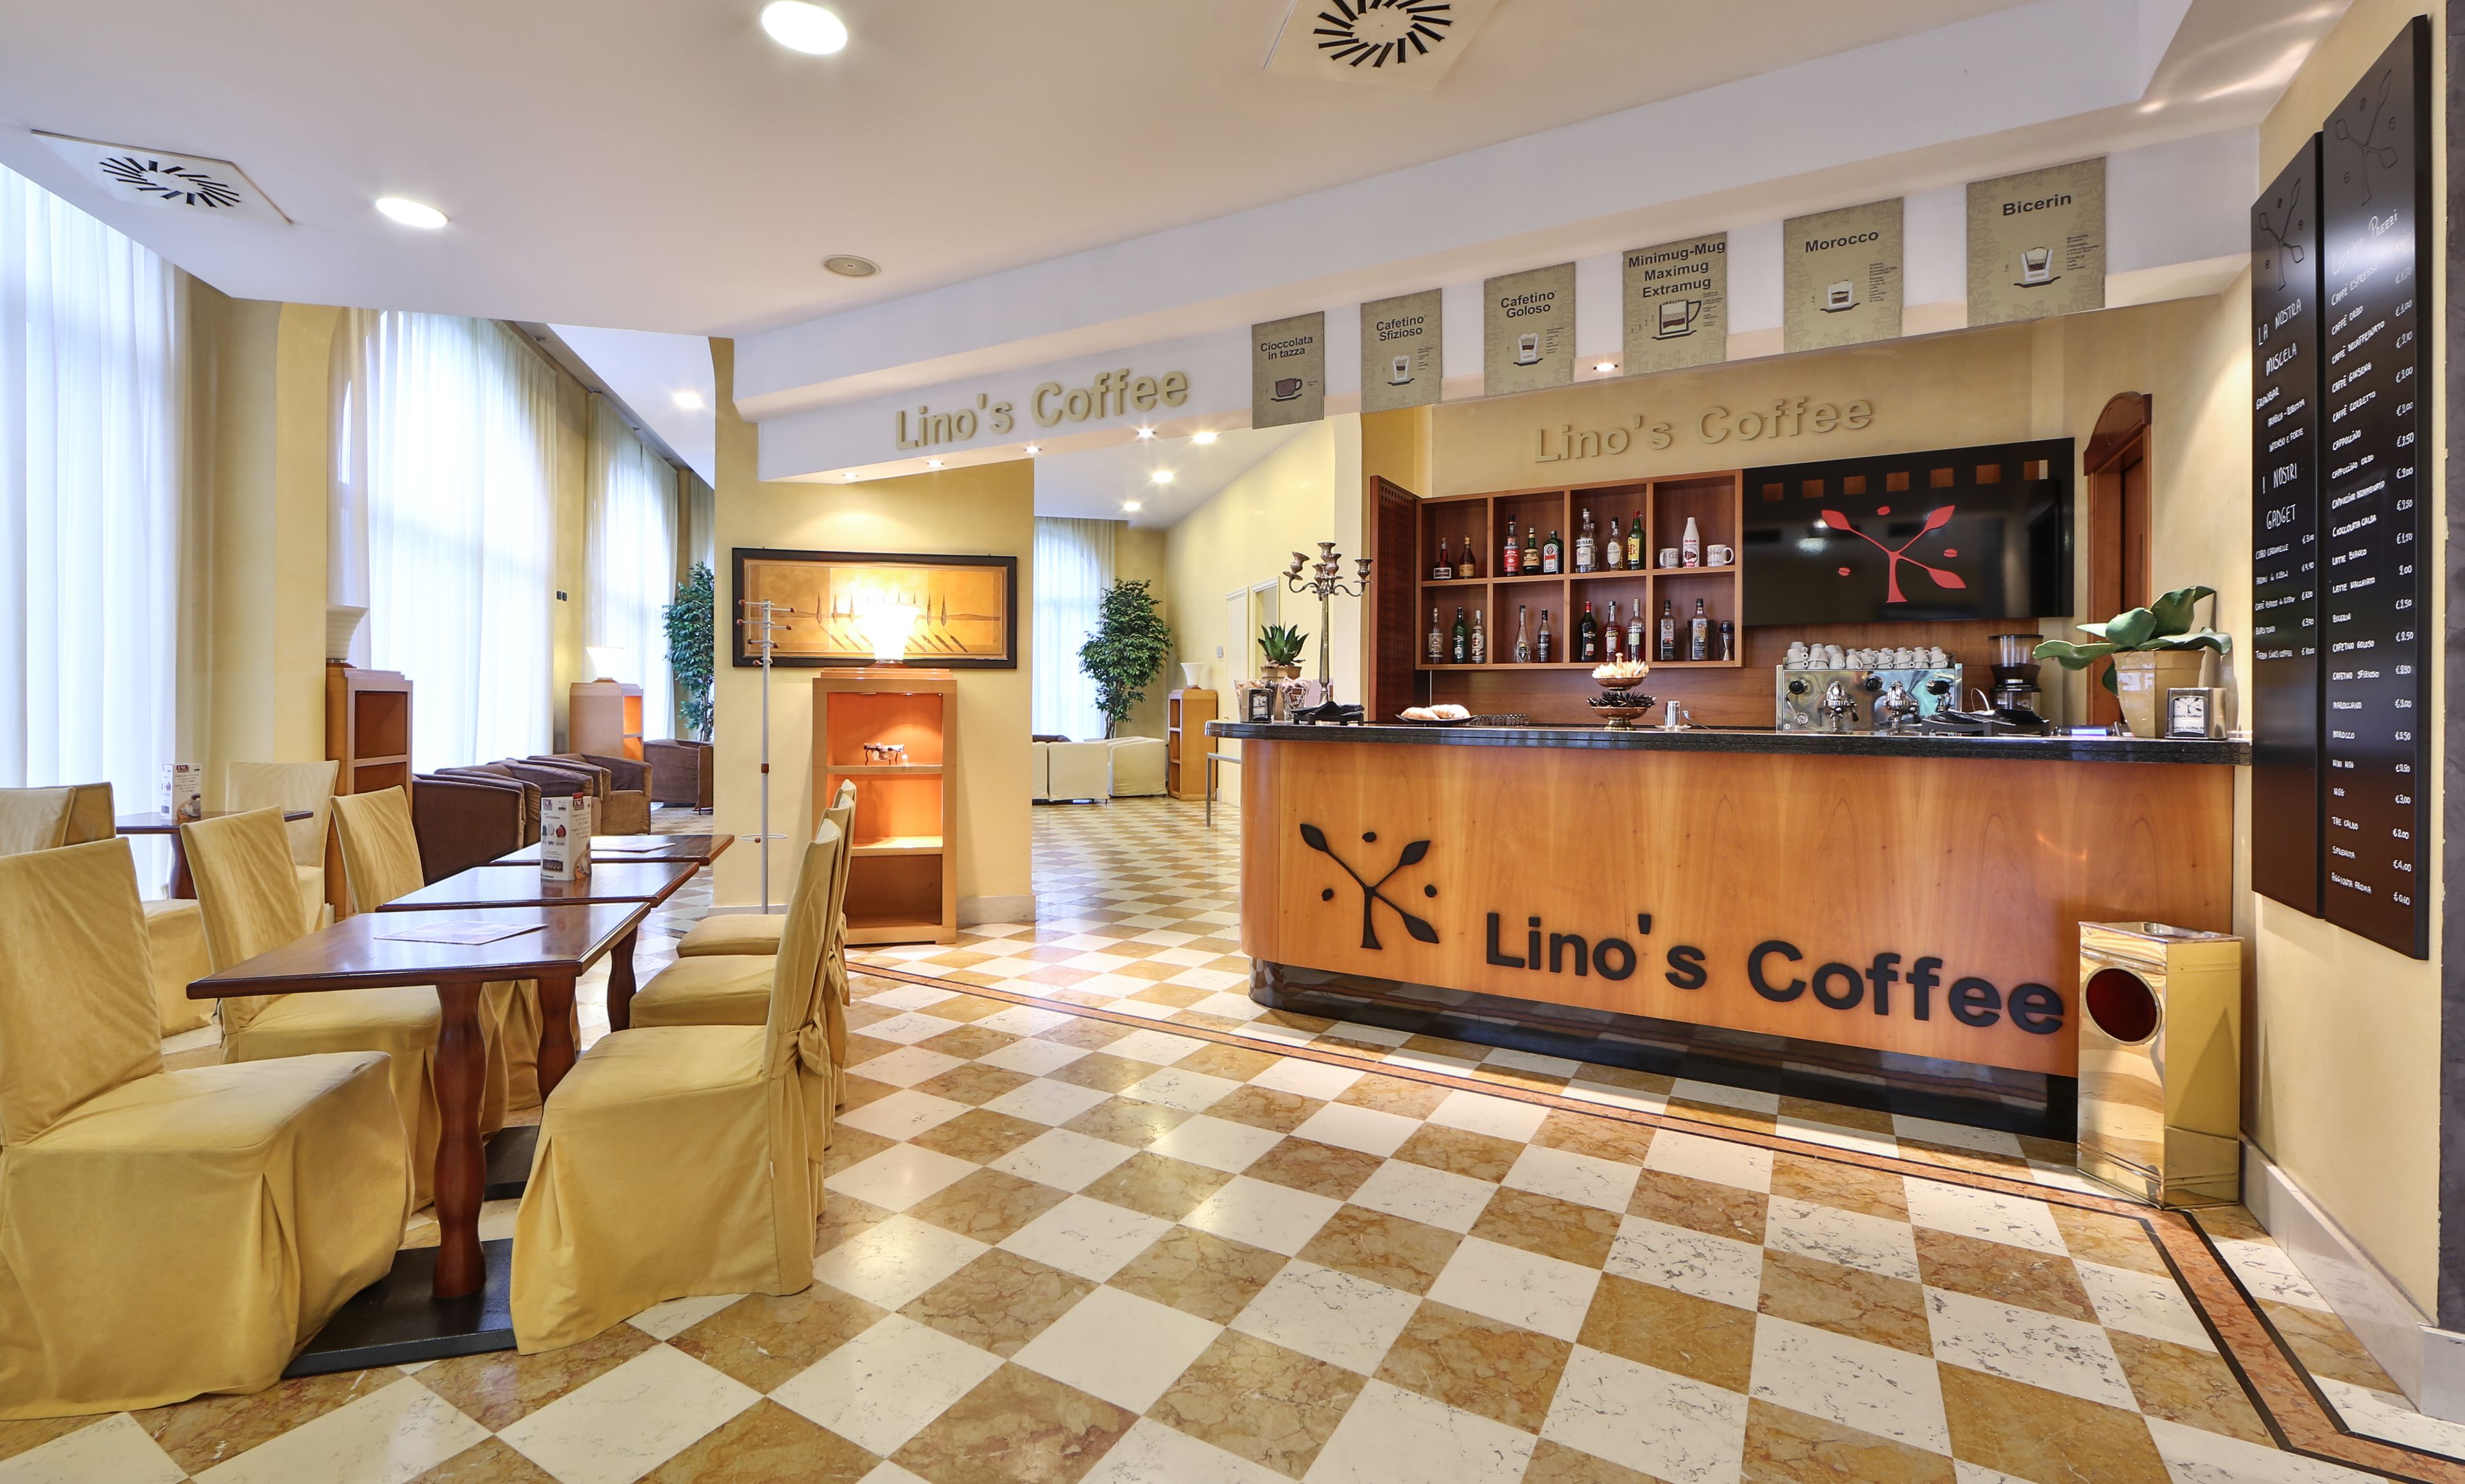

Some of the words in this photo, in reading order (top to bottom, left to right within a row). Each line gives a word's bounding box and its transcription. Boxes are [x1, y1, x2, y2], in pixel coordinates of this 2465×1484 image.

[2003, 194, 2071, 216] Bicerin
[1805, 231, 1879, 253] Morocco
[1628, 240, 1726, 269] Minimug-Mug
[1644, 260, 1709, 282] Maximug
[1642, 277, 1711, 298] Extramug
[1500, 290, 1555, 309] Cafetino
[1506, 302, 1552, 319] Goloso
[1376, 315, 1424, 331] Cafetino
[2258, 323, 2269, 346] LA
[2274, 298, 2302, 330] NOSTRA
[1260, 335, 1314, 353] Cioccolata
[1379, 326, 1423, 342] Sfizioso
[1268, 350, 1277, 360] in
[1279, 345, 1306, 359] tazza
[2266, 342, 2297, 377] MISCELA
[895, 393, 1014, 449] Lino's
[1031, 369, 1188, 427] Coffee
[1535, 415, 1672, 463] Lino's
[1697, 397, 1872, 444] Coffee
[2273, 462, 2298, 489] NOSTRI
[2266, 503, 2296, 530] GADGET
[2332, 555, 2346, 566] LATTE
[2332, 582, 2348, 593] LATTE
[1486, 912, 1708, 990] Lino's
[1747, 940, 2065, 1035] Coffee
